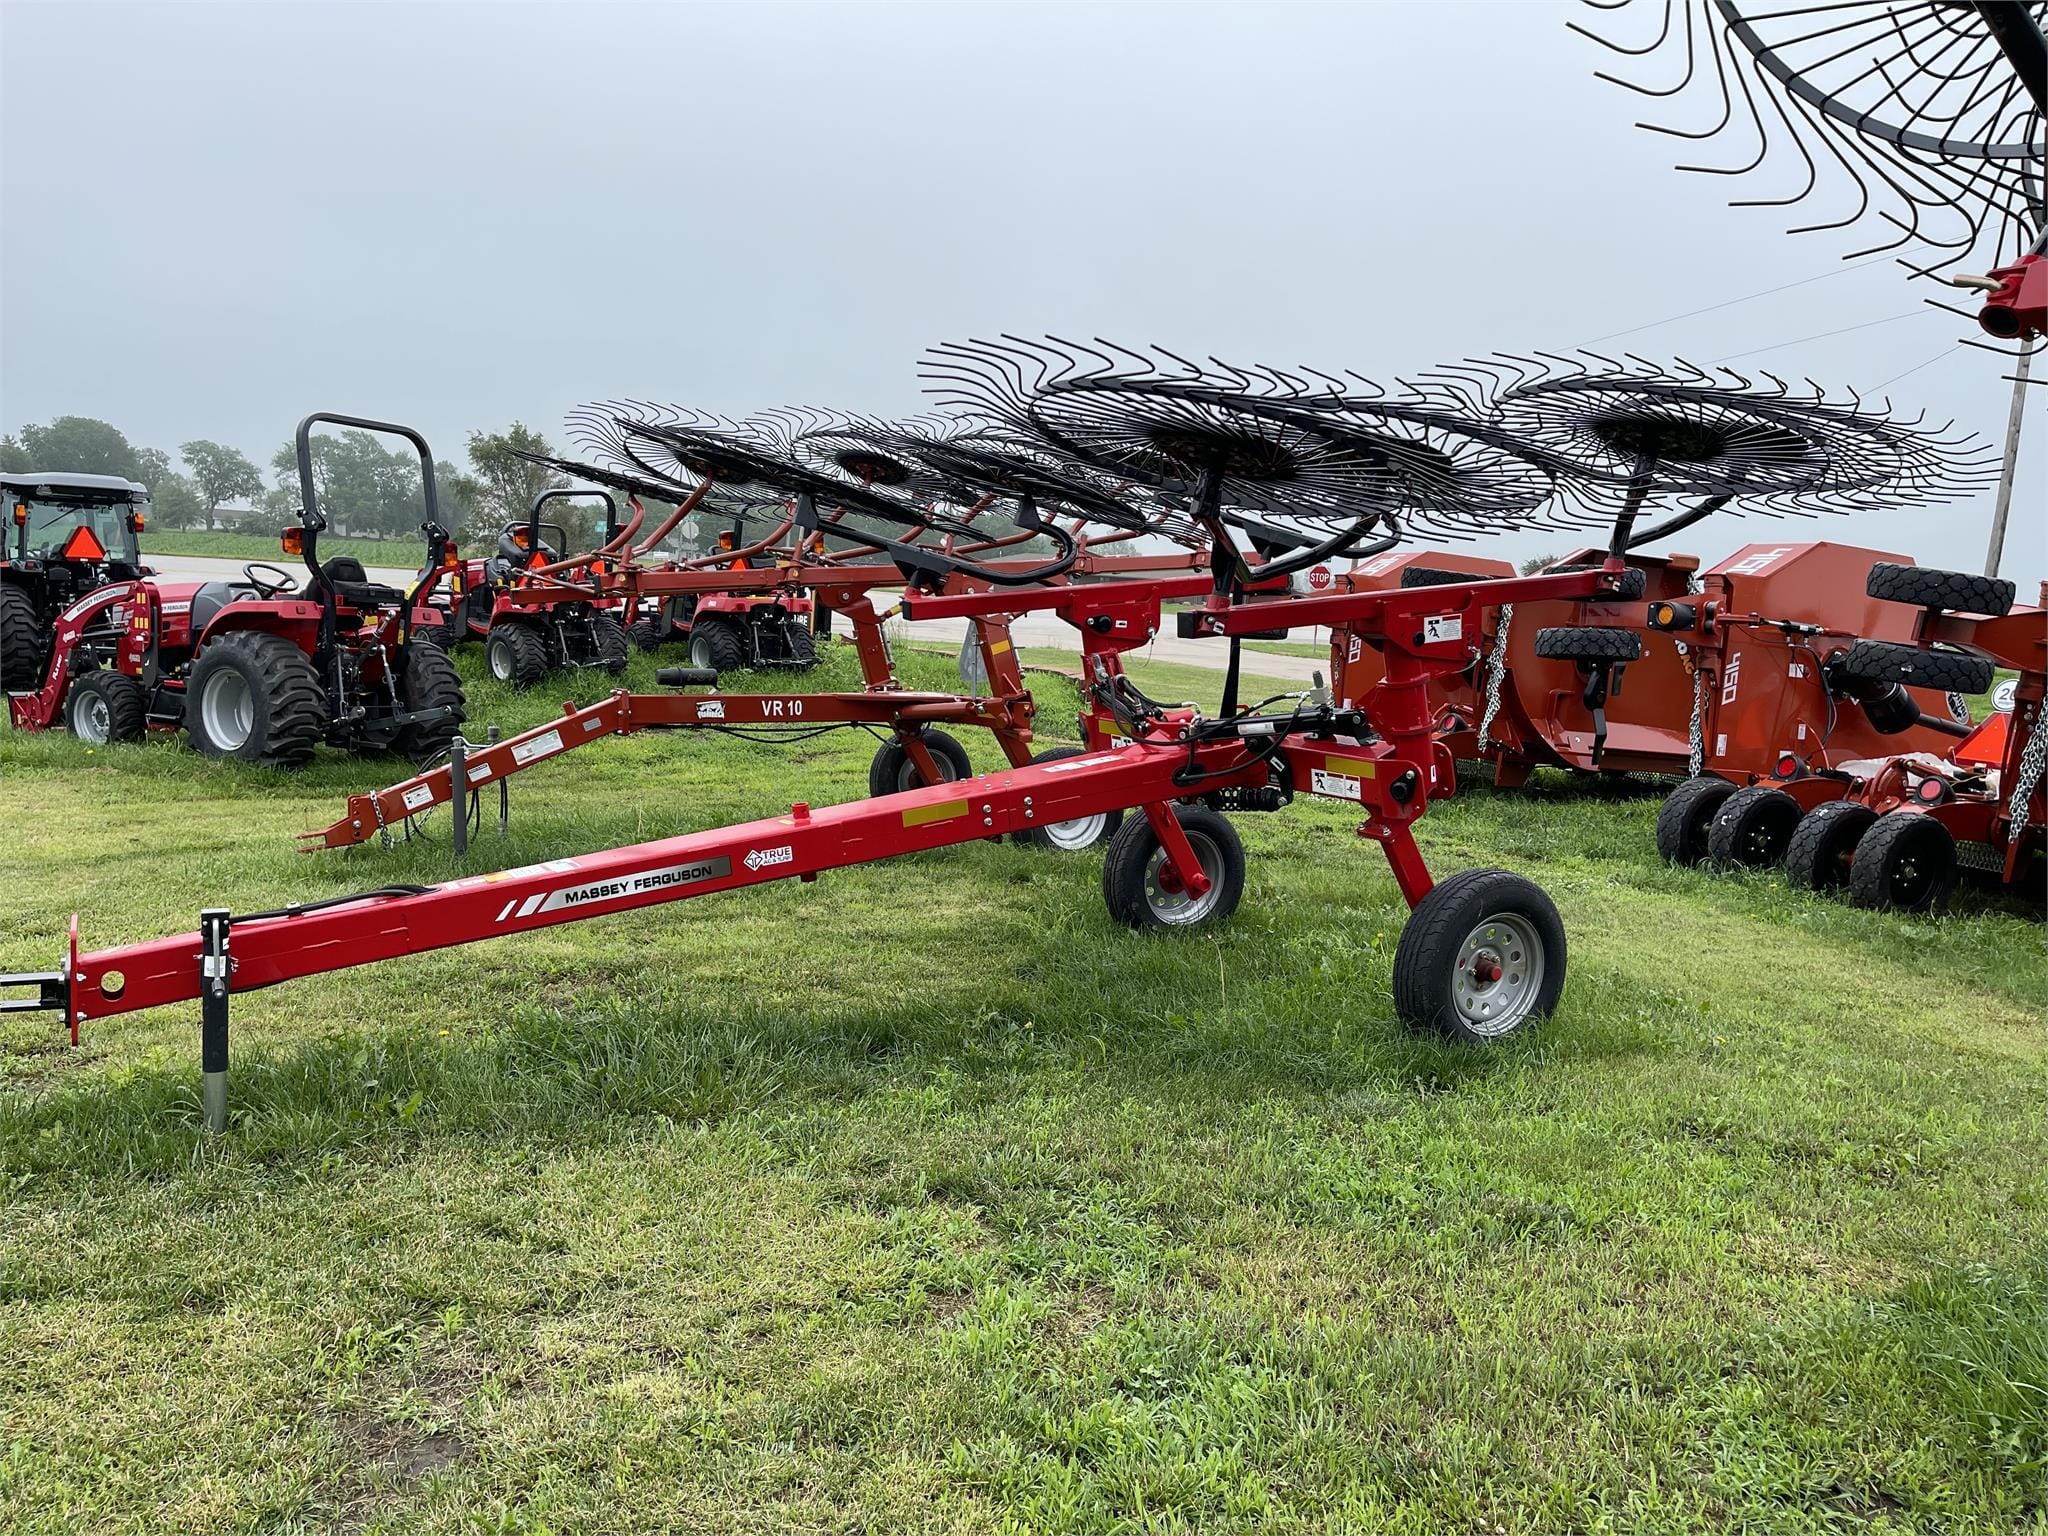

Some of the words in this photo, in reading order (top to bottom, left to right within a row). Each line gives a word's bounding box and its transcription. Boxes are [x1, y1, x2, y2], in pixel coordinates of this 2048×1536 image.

[1310, 573, 1330, 583] STOP
[76, 598, 94, 613] MASSEY
[93, 590, 116, 603] FERGUSON
[1348, 634, 1362, 664] 150
[1721, 651, 1741, 706] 4150
[761, 700, 784, 716] VR
[787, 700, 803, 716] 10
[762, 847, 791, 860] TRUE
[565, 881, 629, 904] MASSEY
[634, 865, 713, 890] FERGUSON
